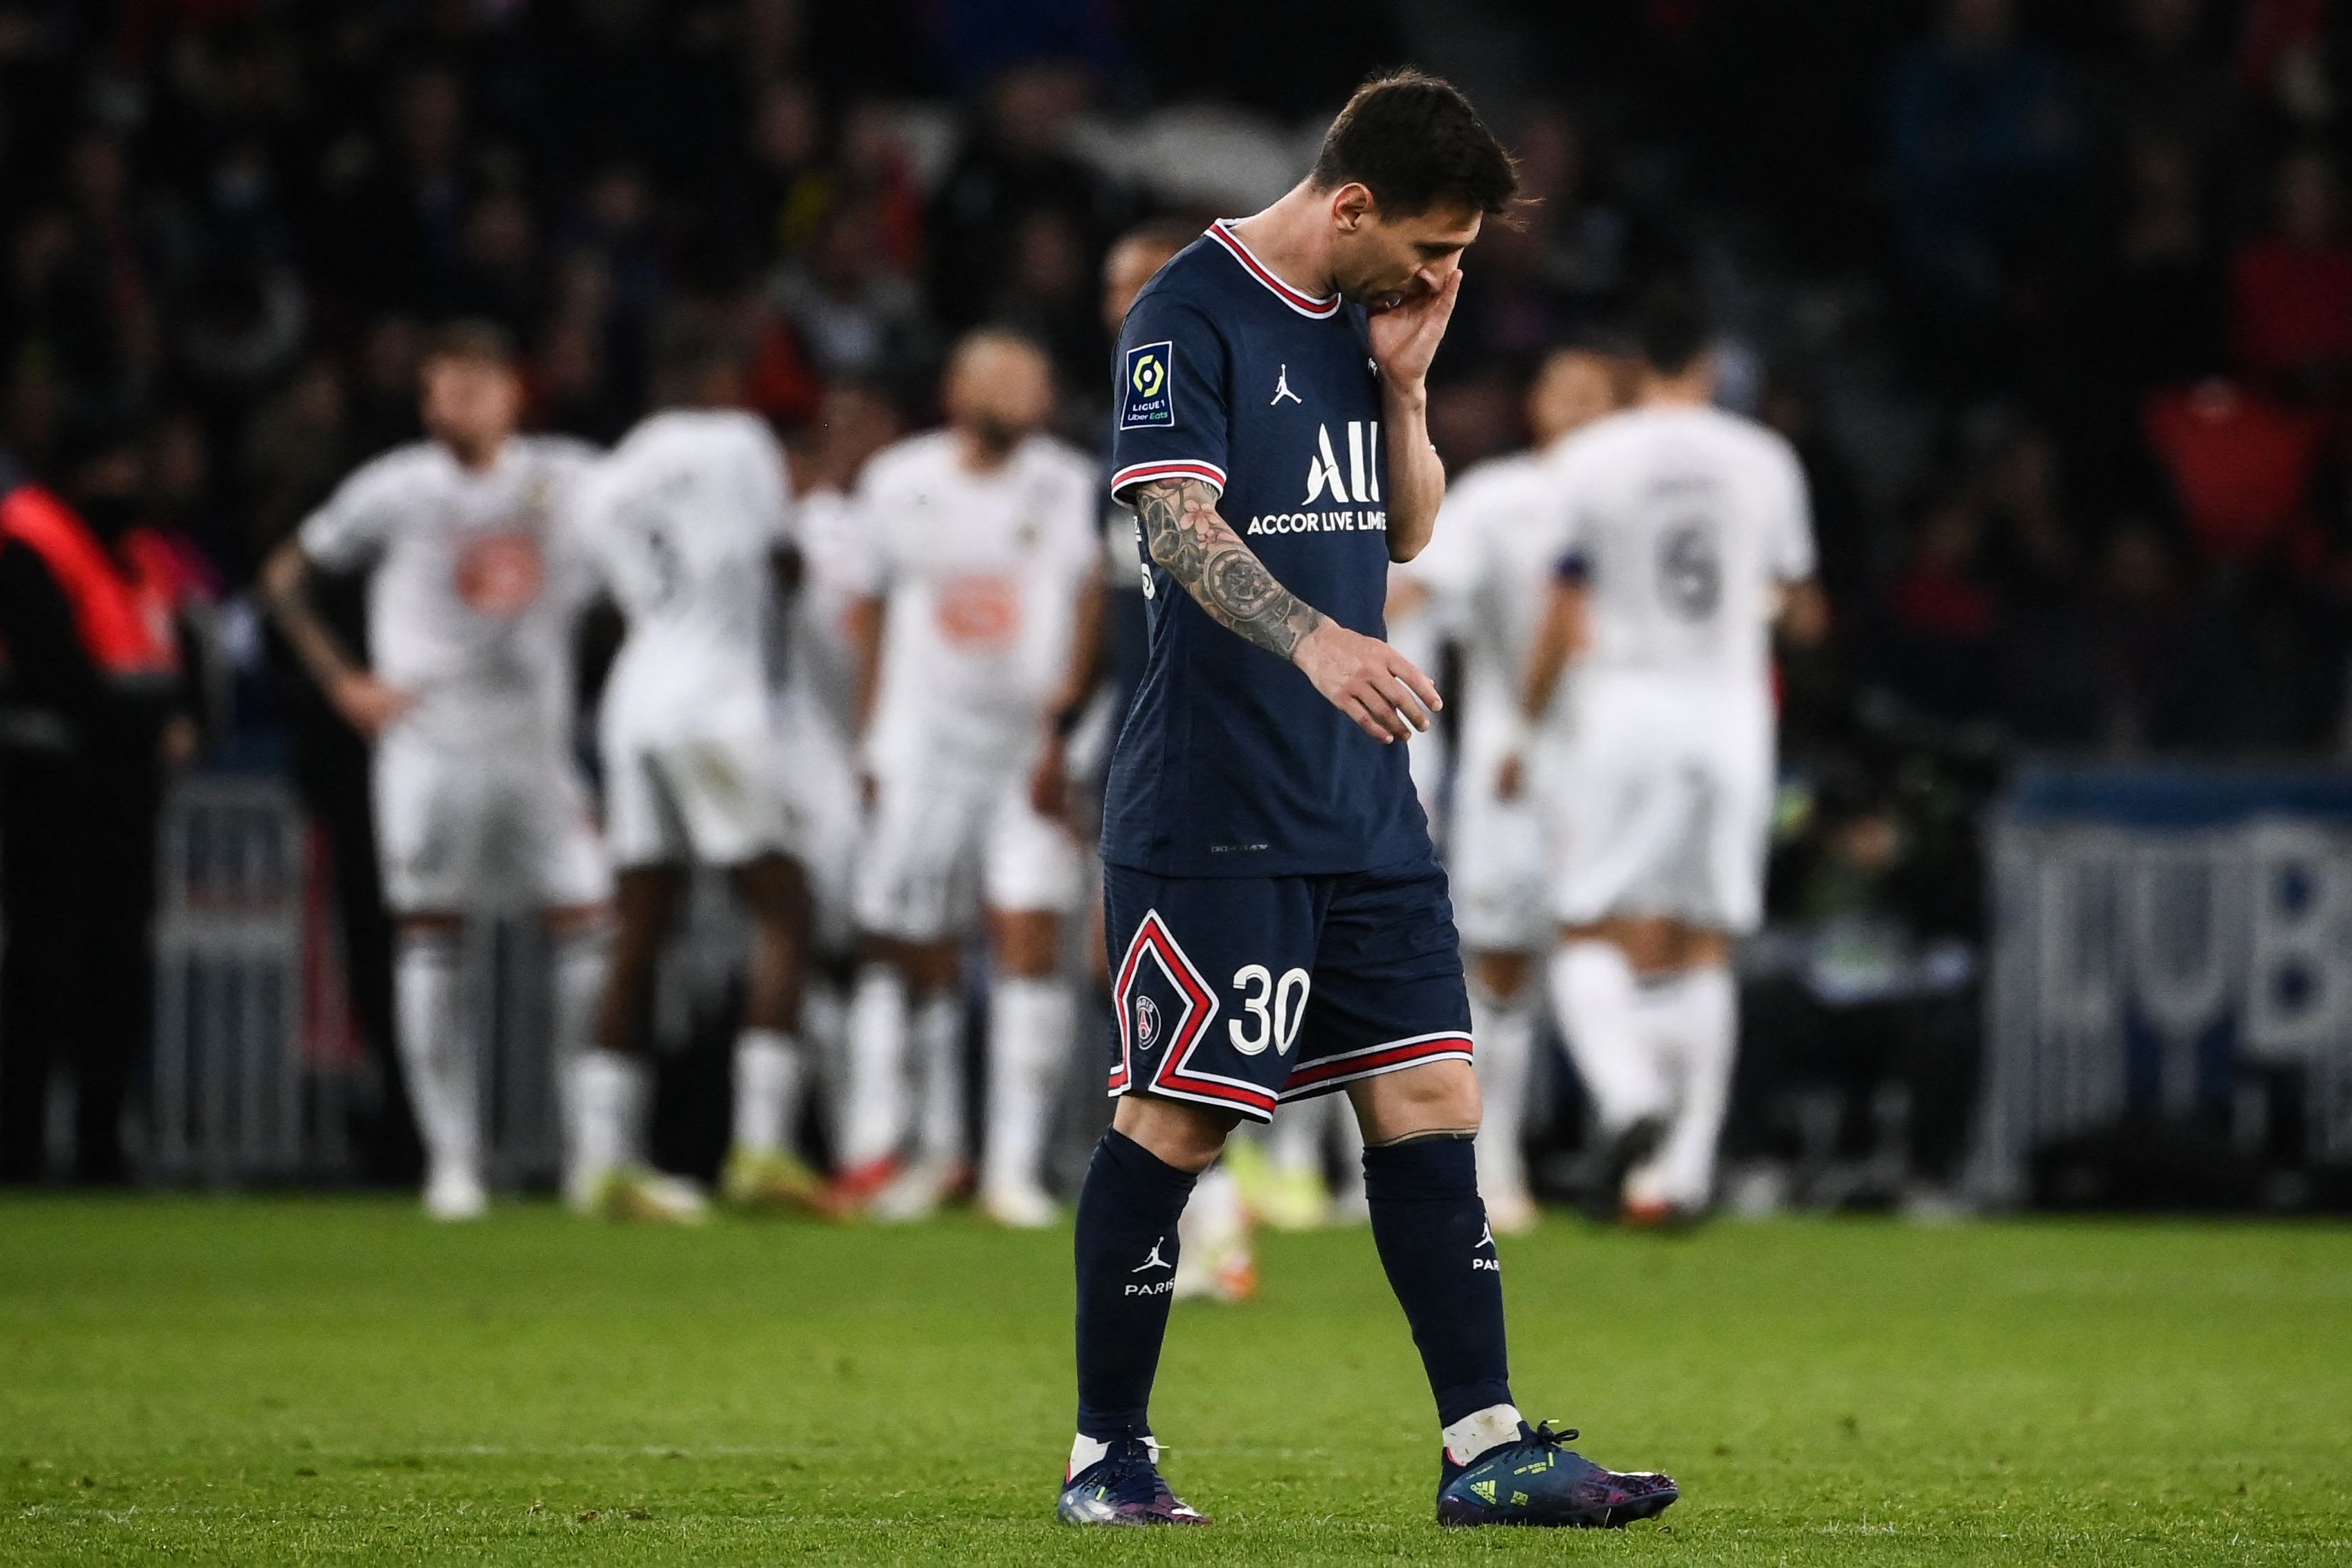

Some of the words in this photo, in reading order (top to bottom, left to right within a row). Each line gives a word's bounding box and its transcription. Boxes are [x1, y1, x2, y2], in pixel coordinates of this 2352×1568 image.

[1132, 401, 1160, 412] LIGUE
[1160, 399, 1165, 407] 1
[1149, 411, 1168, 419] Eats
[1247, 513, 1319, 535] ACCOR
[1321, 511, 1354, 531] LIVE
[1229, 964, 1310, 1056] 30
